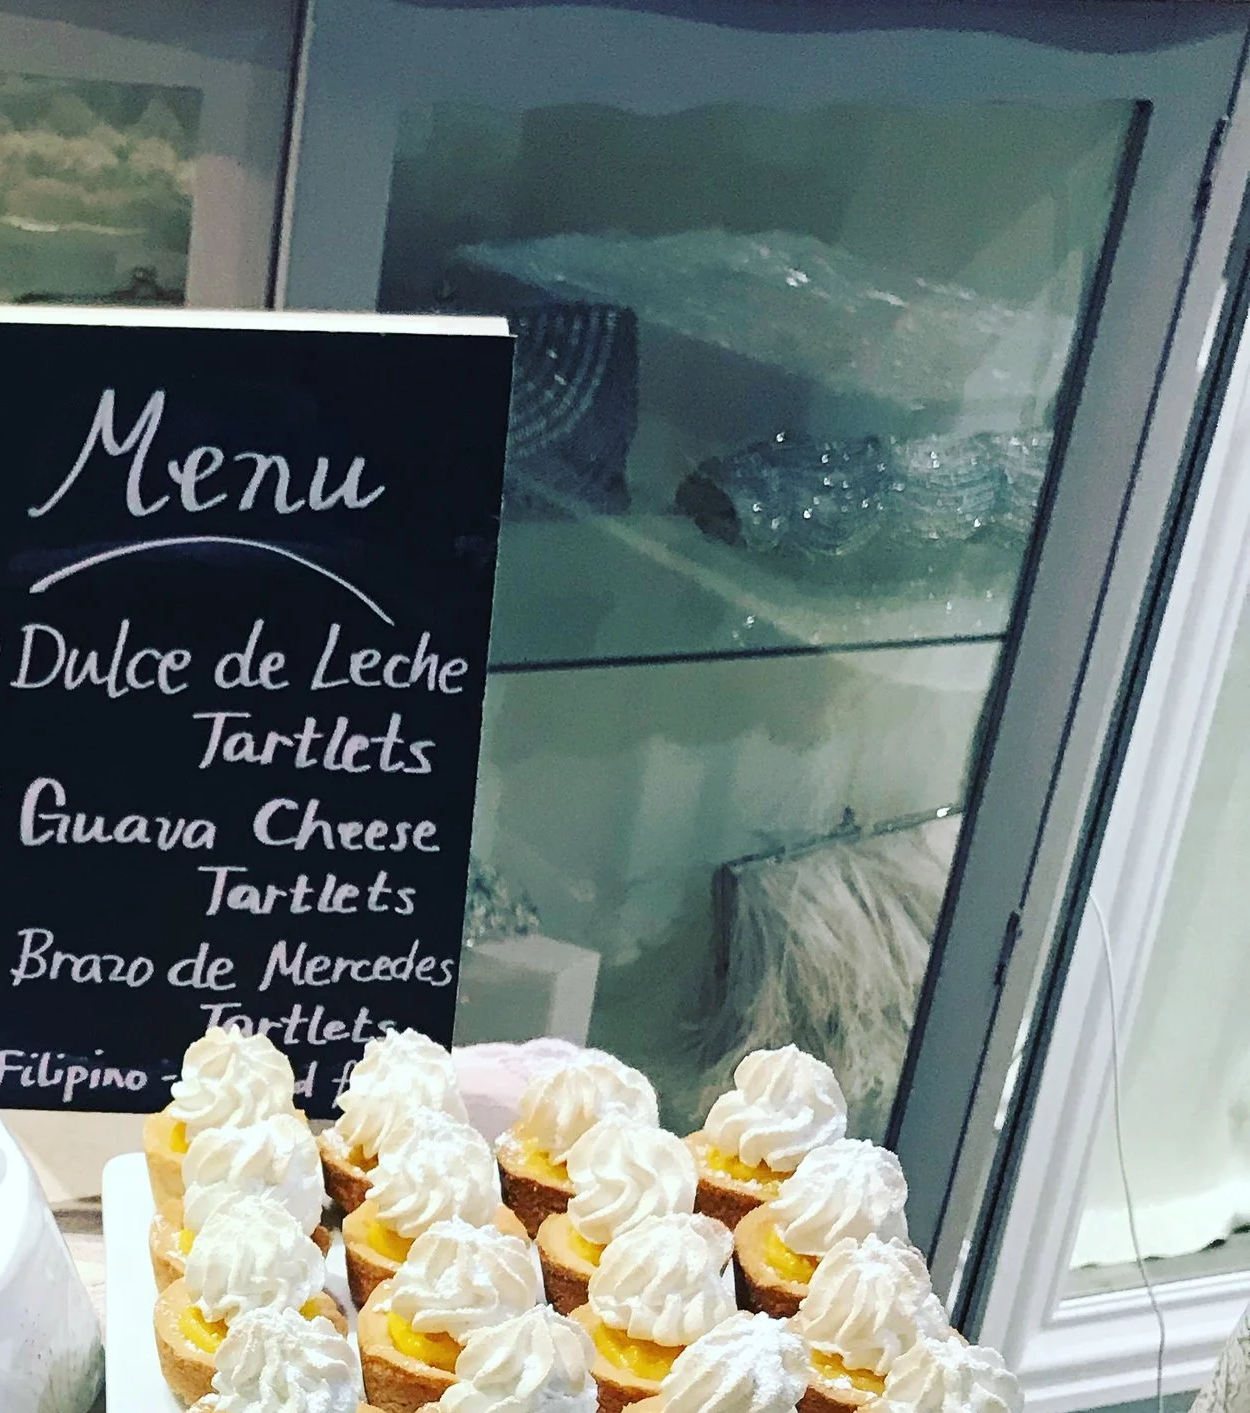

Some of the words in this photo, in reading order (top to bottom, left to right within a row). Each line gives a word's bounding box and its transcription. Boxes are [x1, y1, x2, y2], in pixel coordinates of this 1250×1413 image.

[27, 387, 386, 517] Menu
[10, 618, 192, 698] Dulce
[213, 618, 288, 690] de
[310, 622, 470, 694] Leche
[192, 711, 437, 774] Tartlets
[19, 776, 218, 851] Guava
[252, 797, 441, 852] Cheese
[197, 865, 417, 916] Tartlets
[10, 927, 154, 988] Brazo
[166, 942, 237, 991] de
[258, 938, 456, 992] Mercedes
